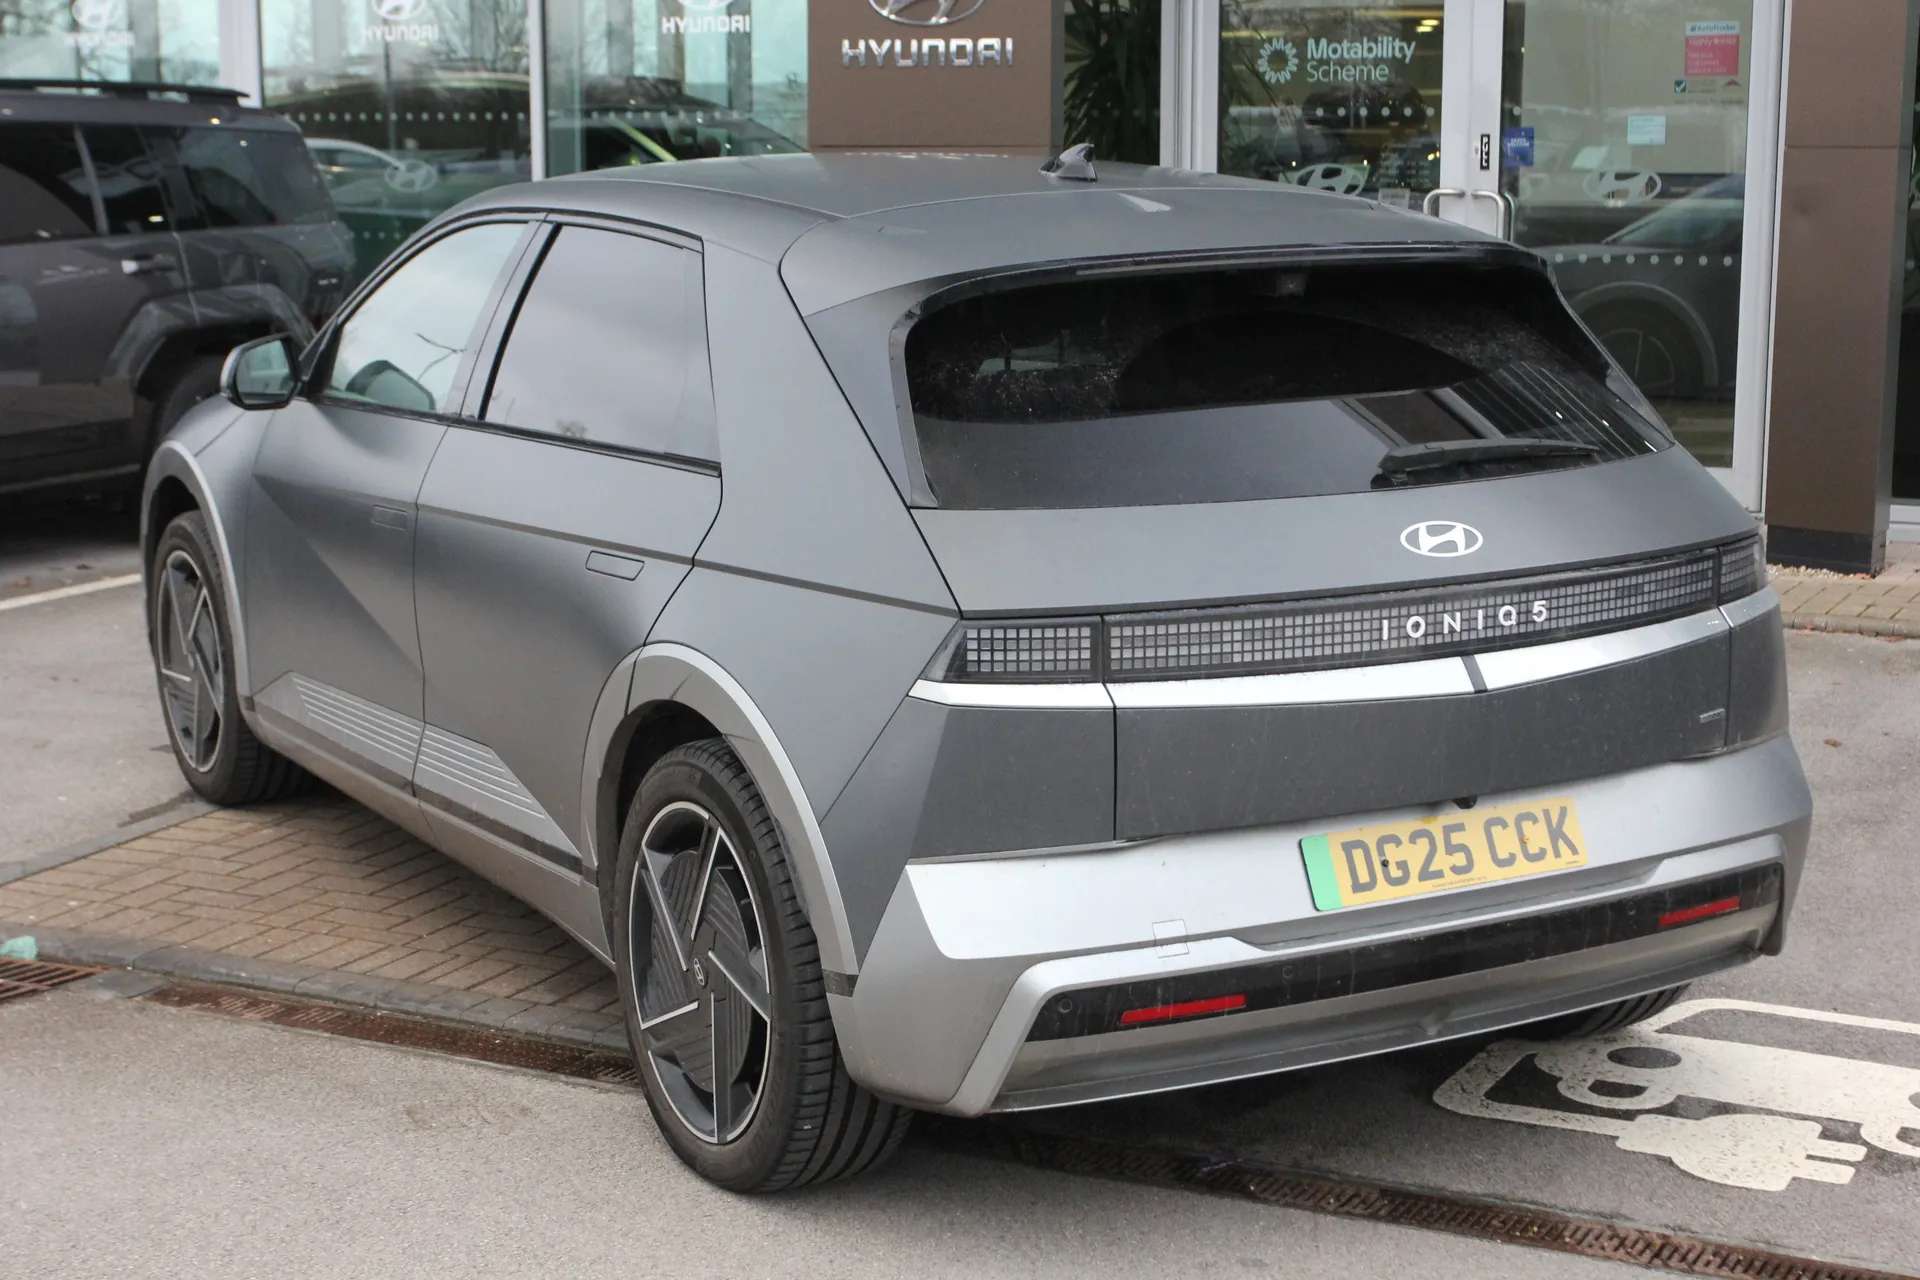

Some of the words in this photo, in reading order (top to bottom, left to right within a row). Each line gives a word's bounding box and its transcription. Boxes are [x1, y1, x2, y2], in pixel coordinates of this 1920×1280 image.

[661, 14, 751, 34] HYUNDAI
[841, 37, 1014, 68] HYUNDAI
[1306, 36, 1416, 64] Motability
[1306, 61, 1389, 82] Scheme
[1382, 605, 1517, 641] IONIQ
[1532, 600, 1547, 623] 5
[1341, 821, 1475, 894] DG25
[1483, 806, 1579, 868] CCK
